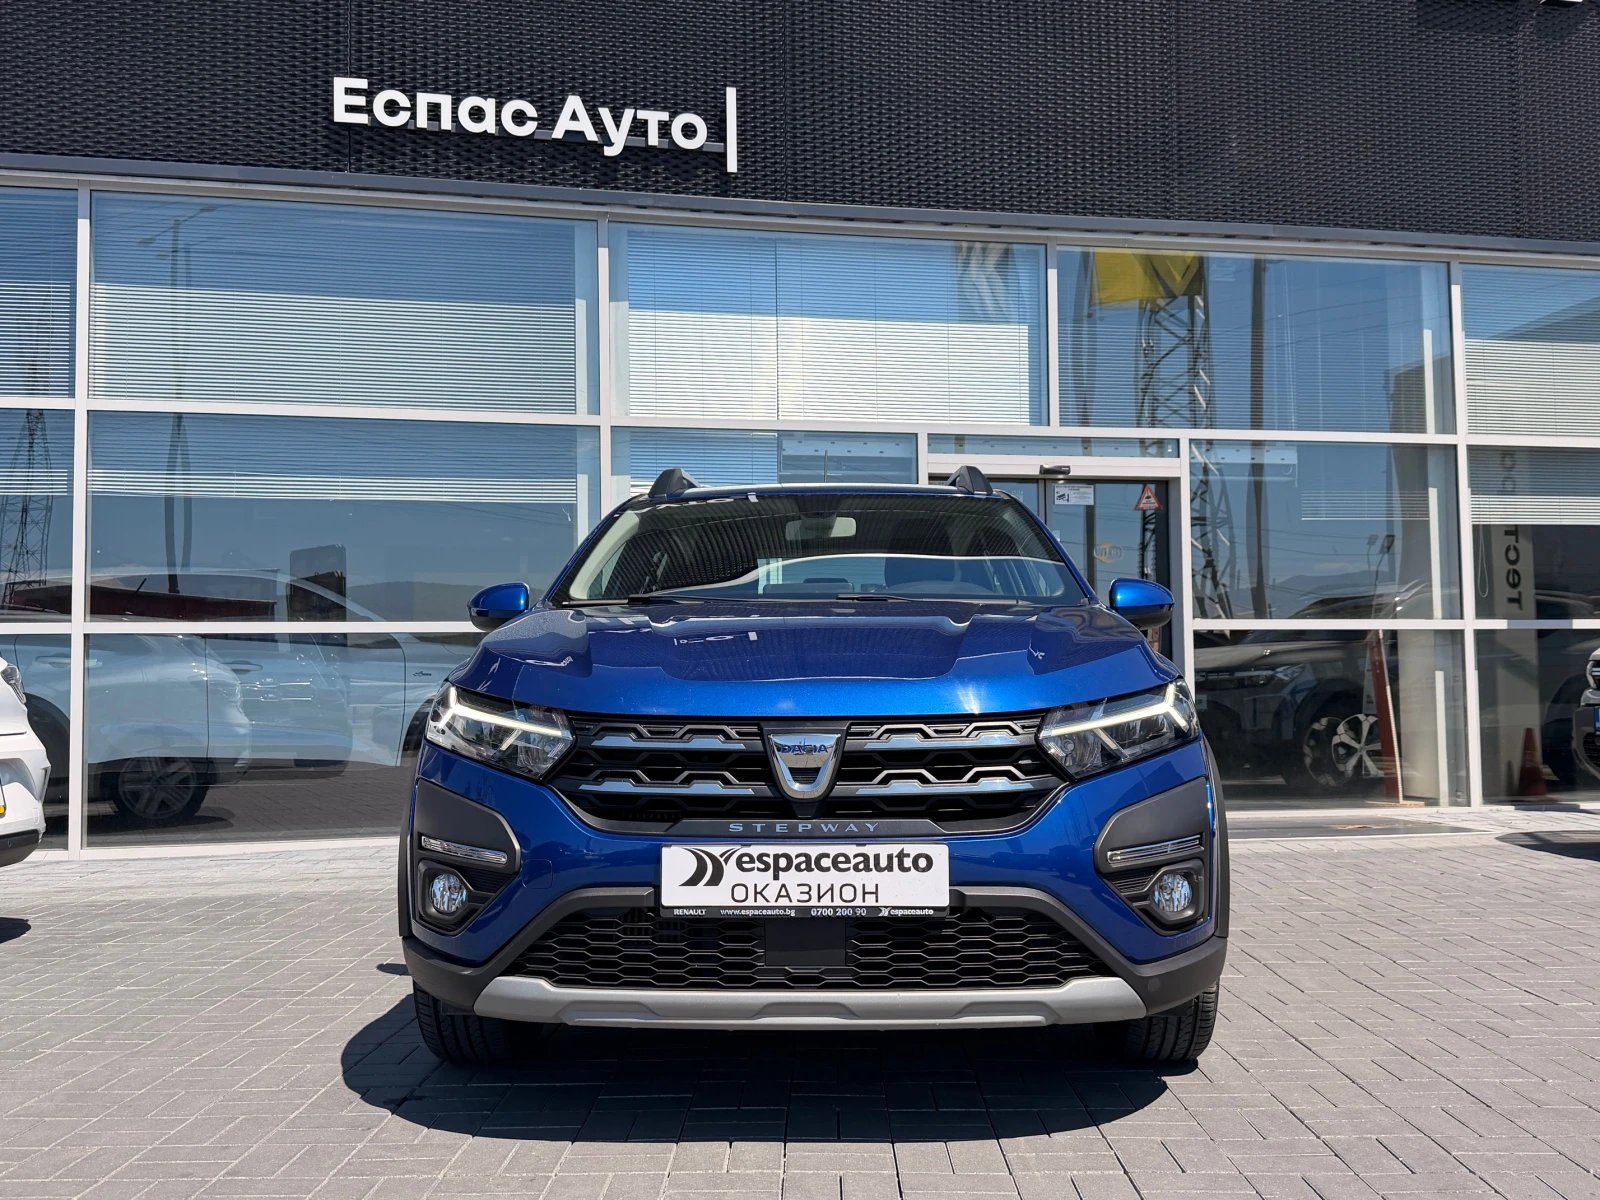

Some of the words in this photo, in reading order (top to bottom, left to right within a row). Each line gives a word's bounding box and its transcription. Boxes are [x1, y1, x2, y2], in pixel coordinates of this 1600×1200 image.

[333, 76, 538, 137] Еспас
[551, 95, 708, 157] Ауто
[780, 744, 829, 754] DACIA
[728, 822, 880, 833] STEPWAY
[735, 847, 934, 881] espaceauto
[730, 883, 879, 904] ОКАЗИОН
[673, 908, 706, 916] RENAULT
[720, 908, 795, 917] www.espaceauto.bg
[811, 908, 833, 916] 0700
[835, 908, 853, 916] 200
[854, 908, 867, 916] 90
[890, 909, 934, 917] espaceauto
